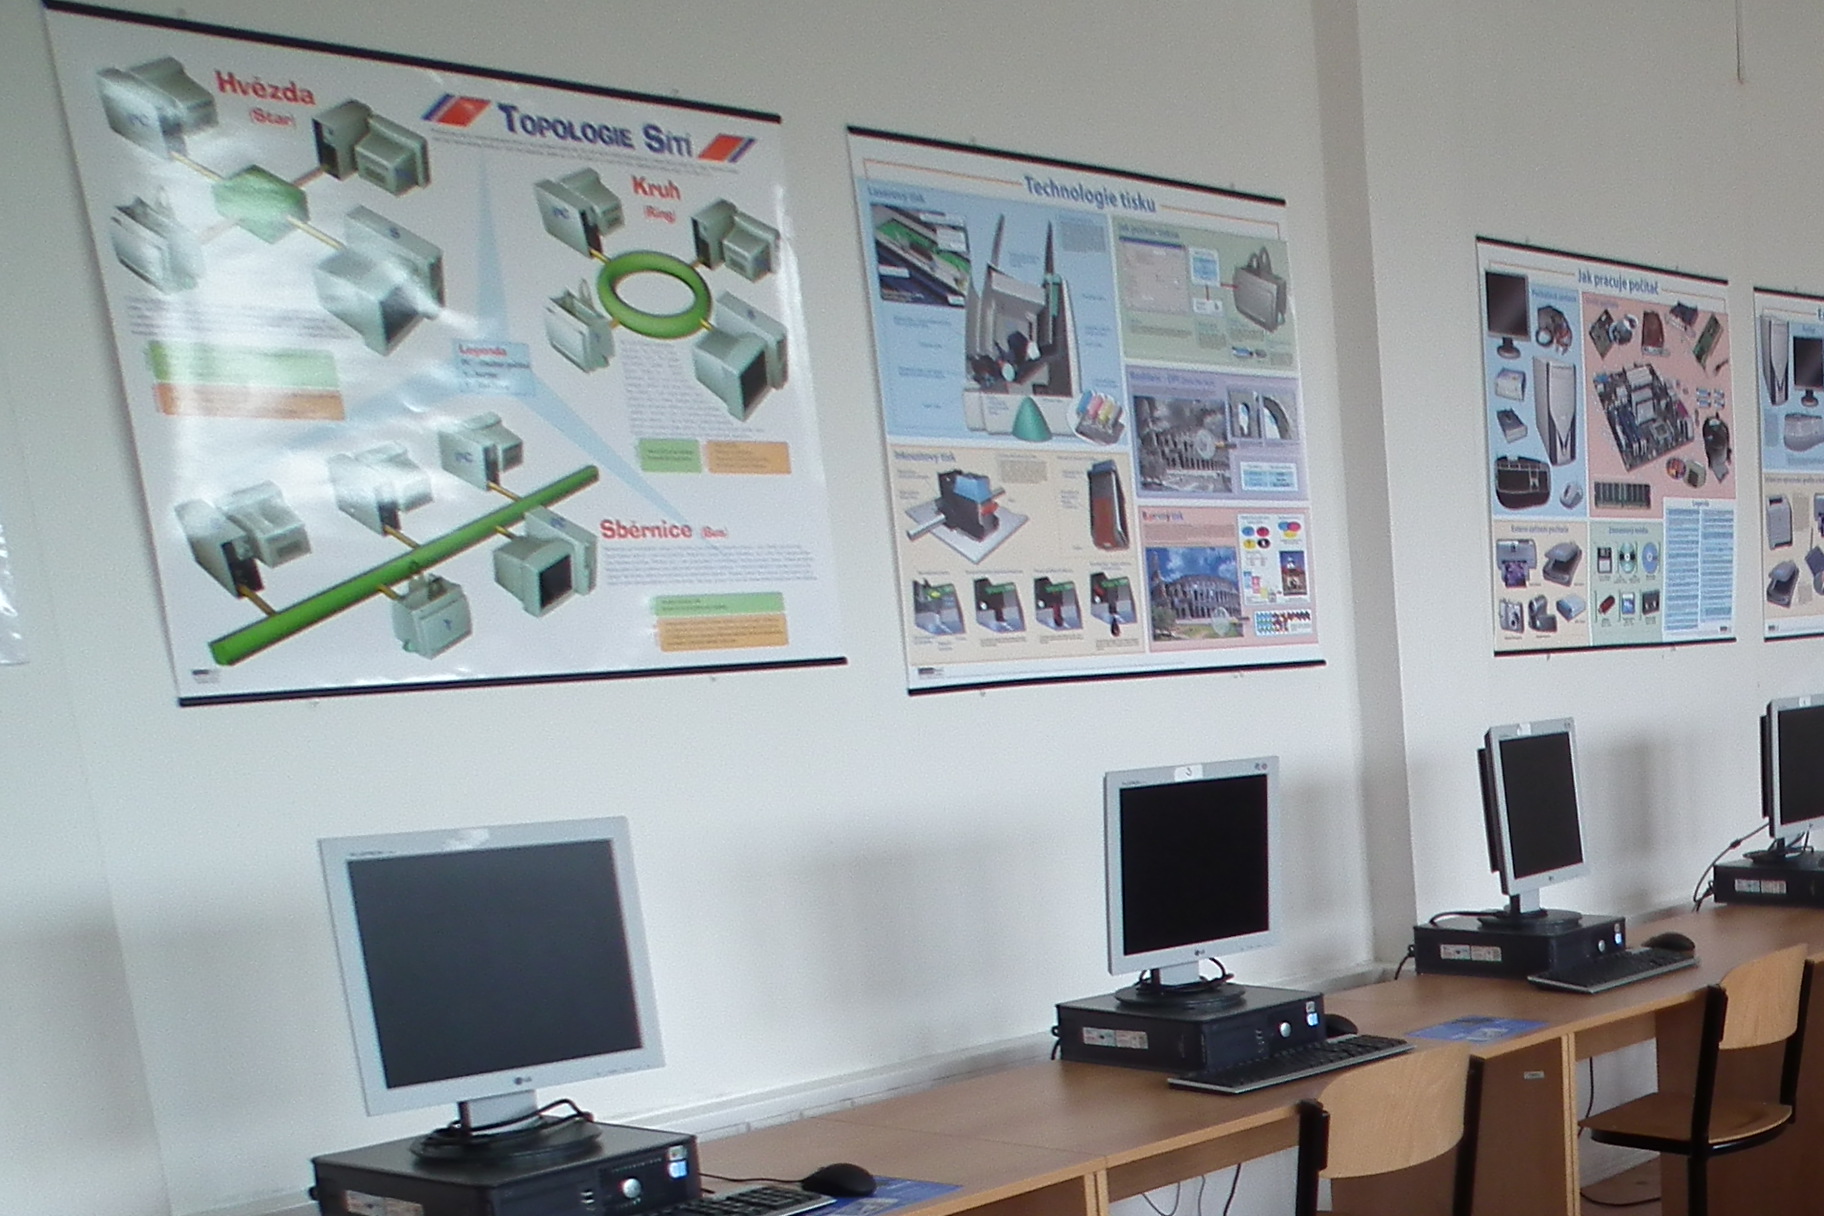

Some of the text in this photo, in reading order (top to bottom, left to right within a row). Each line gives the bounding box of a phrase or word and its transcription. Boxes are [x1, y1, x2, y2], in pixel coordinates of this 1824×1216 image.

[631, 176, 682, 200] Kruh
[1024, 174, 1156, 213] Technologie tisku
[1578, 268, 1592, 284] Jak
[1593, 271, 1627, 293] pracuje
